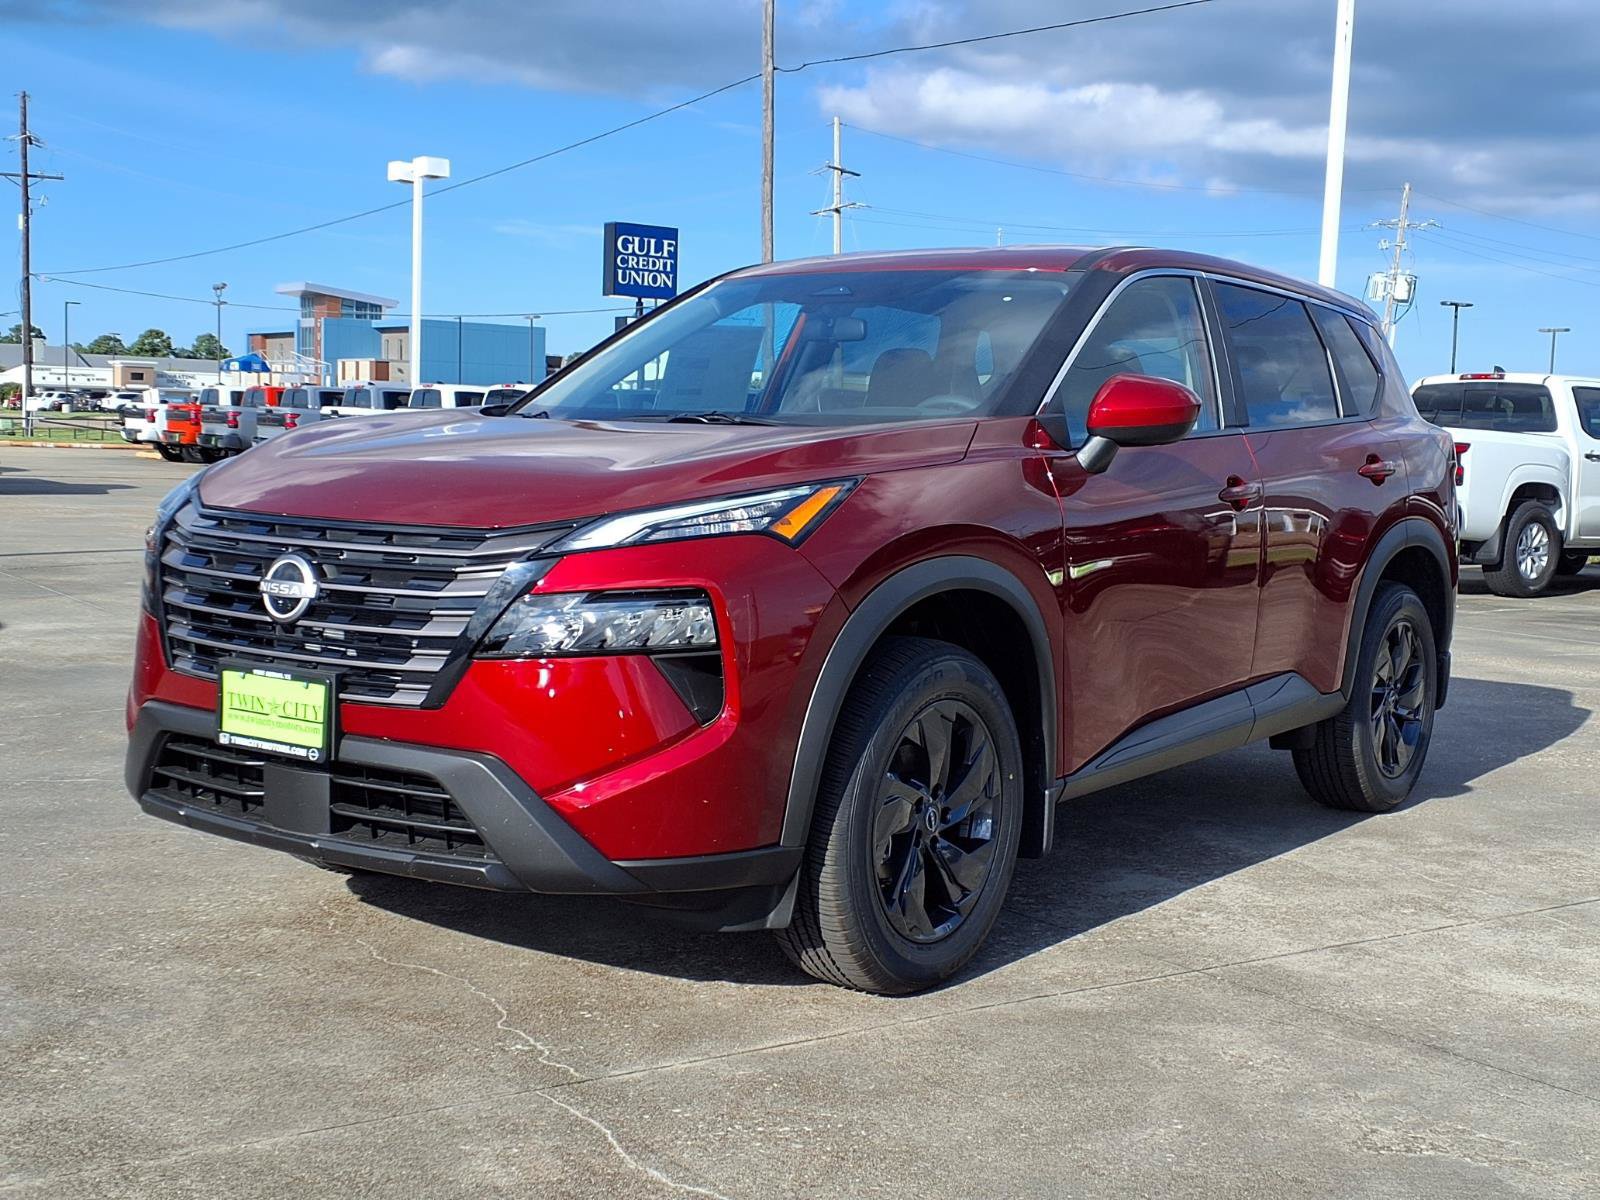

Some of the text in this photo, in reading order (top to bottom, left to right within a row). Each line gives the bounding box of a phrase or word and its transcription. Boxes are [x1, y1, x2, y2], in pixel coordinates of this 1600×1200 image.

[617, 235, 676, 257] GULF
[616, 254, 674, 271] CREDIT
[616, 269, 674, 288] UNION
[259, 581, 313, 597] NISSA
[227, 691, 322, 721] TWIN CITY
